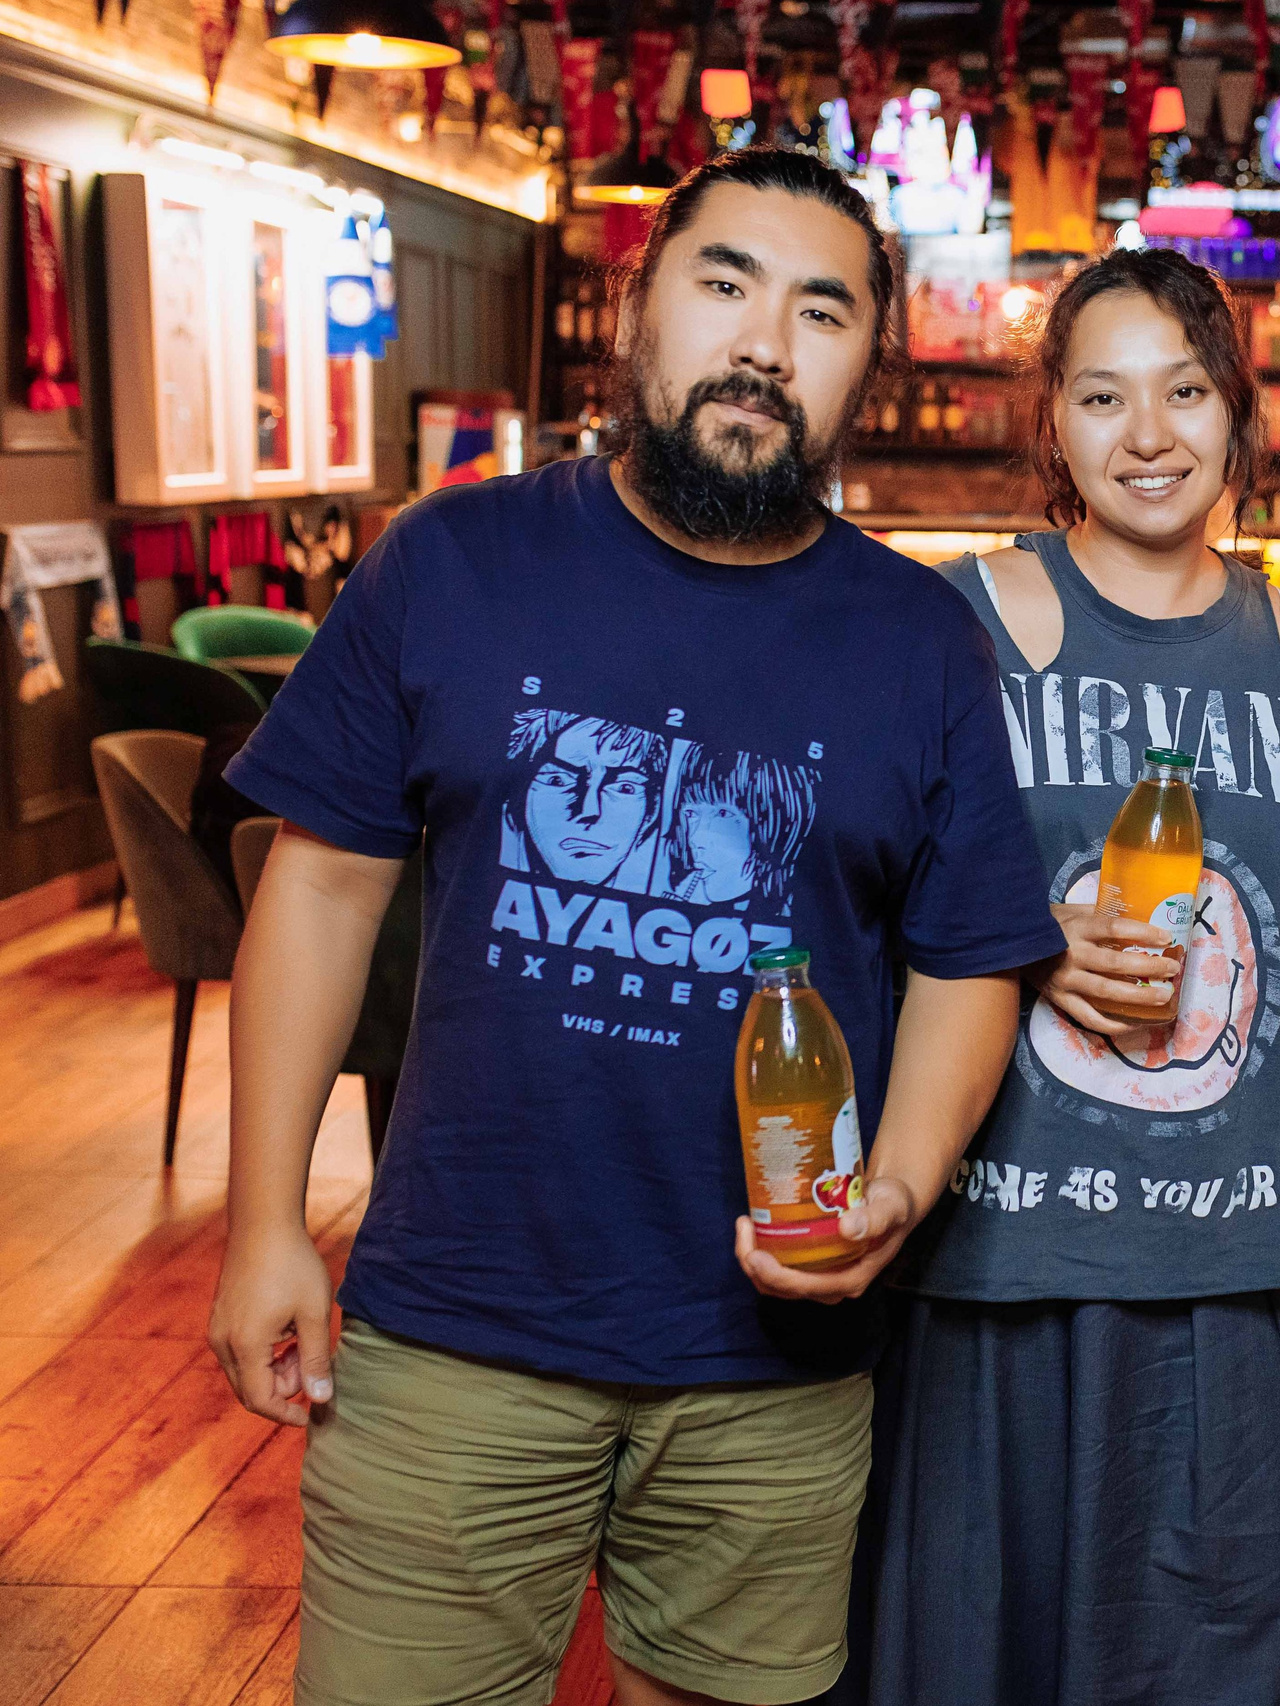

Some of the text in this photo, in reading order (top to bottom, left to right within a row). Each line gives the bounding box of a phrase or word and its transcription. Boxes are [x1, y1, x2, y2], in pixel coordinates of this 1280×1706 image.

[562, 1014, 605, 1034] VHS
[627, 1026, 681, 1047] IMAX
[951, 1158, 1048, 1212] COME
[1058, 1166, 1119, 1212] AS
[1141, 1175, 1225, 1218] YOU
